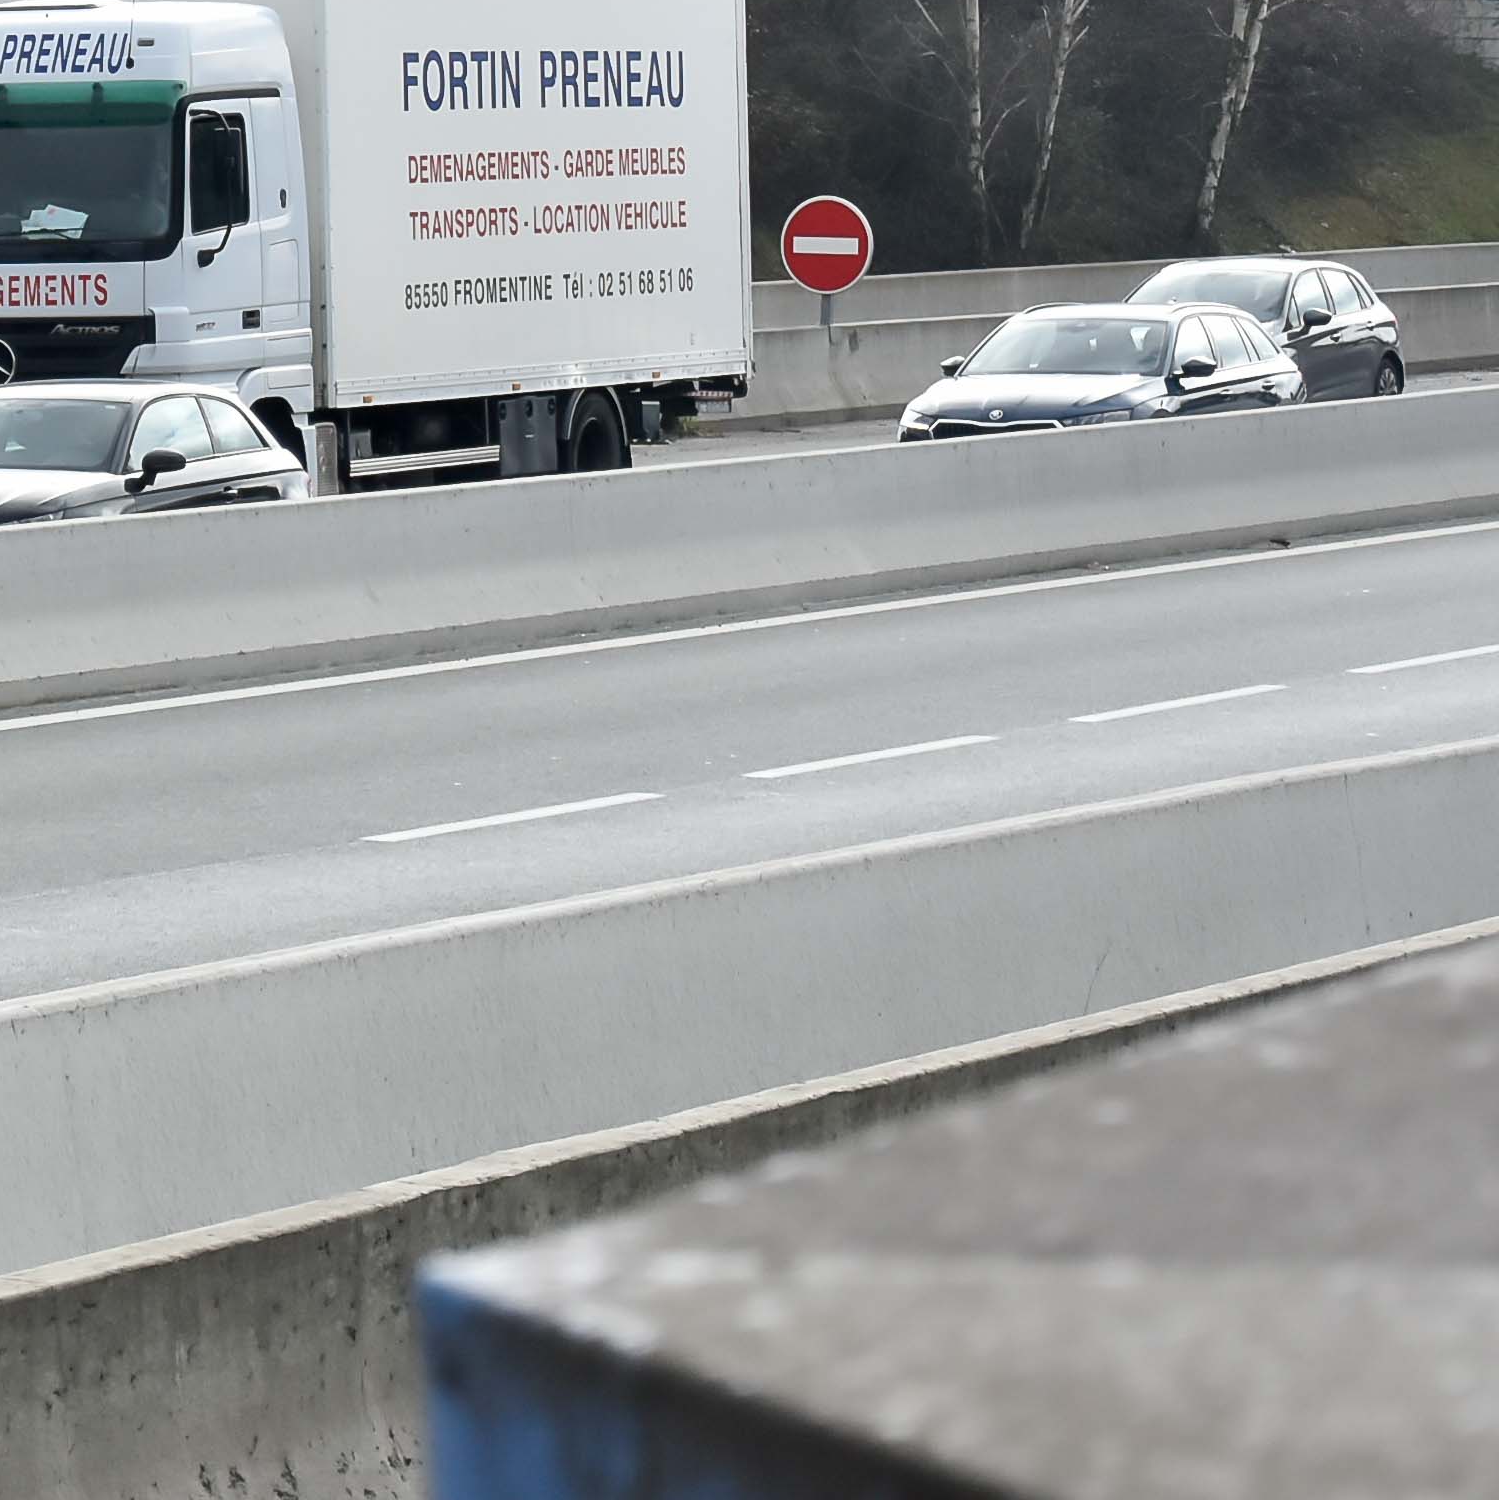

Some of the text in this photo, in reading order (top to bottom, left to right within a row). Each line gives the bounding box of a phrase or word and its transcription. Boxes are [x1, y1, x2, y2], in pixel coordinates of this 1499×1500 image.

[0, 33, 129, 75] PRENEAU
[402, 50, 684, 111] FORTIN PRENEAU
[408, 150, 550, 184] DEMENAGEMENTS
[563, 149, 614, 179] GARDE
[618, 146, 686, 177] MEUBLES
[409, 206, 519, 241] TRANSPORTS
[533, 203, 610, 235] LOCATION
[614, 200, 688, 230] VEHICULE
[404, 281, 449, 310] 85550
[454, 274, 553, 305] FROMENTINE
[563, 271, 584, 299] Tél
[598, 272, 614, 297] 02
[618, 271, 633, 296] 51
[638, 269, 654, 294] 68
[659, 268, 673, 293] 51
[678, 267, 694, 292] 06
